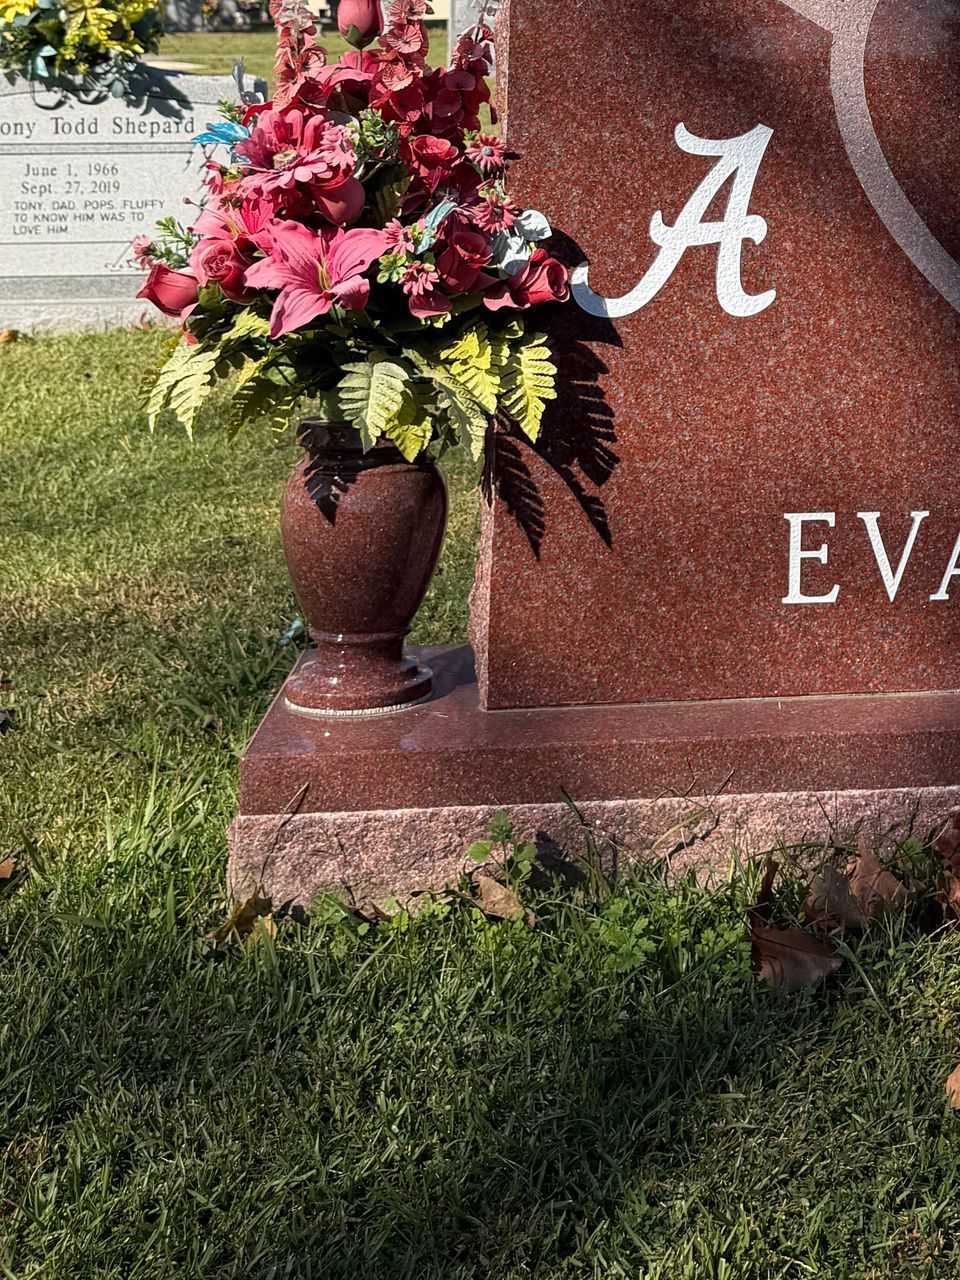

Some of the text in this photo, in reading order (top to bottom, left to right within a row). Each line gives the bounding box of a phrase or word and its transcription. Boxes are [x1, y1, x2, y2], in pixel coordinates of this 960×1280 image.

[0, 116, 195, 138] ony Todd Shepard
[24, 163, 57, 177] June
[88, 163, 119, 176] 1966
[21, 180, 121, 197] Sept. 27, 2019
[123, 199, 165, 209] FLUFFY
[14, 211, 144, 223] TO KNOW HIM WAS TO
[571, 122, 776, 317] A
[13, 225, 41, 235] LOVE
